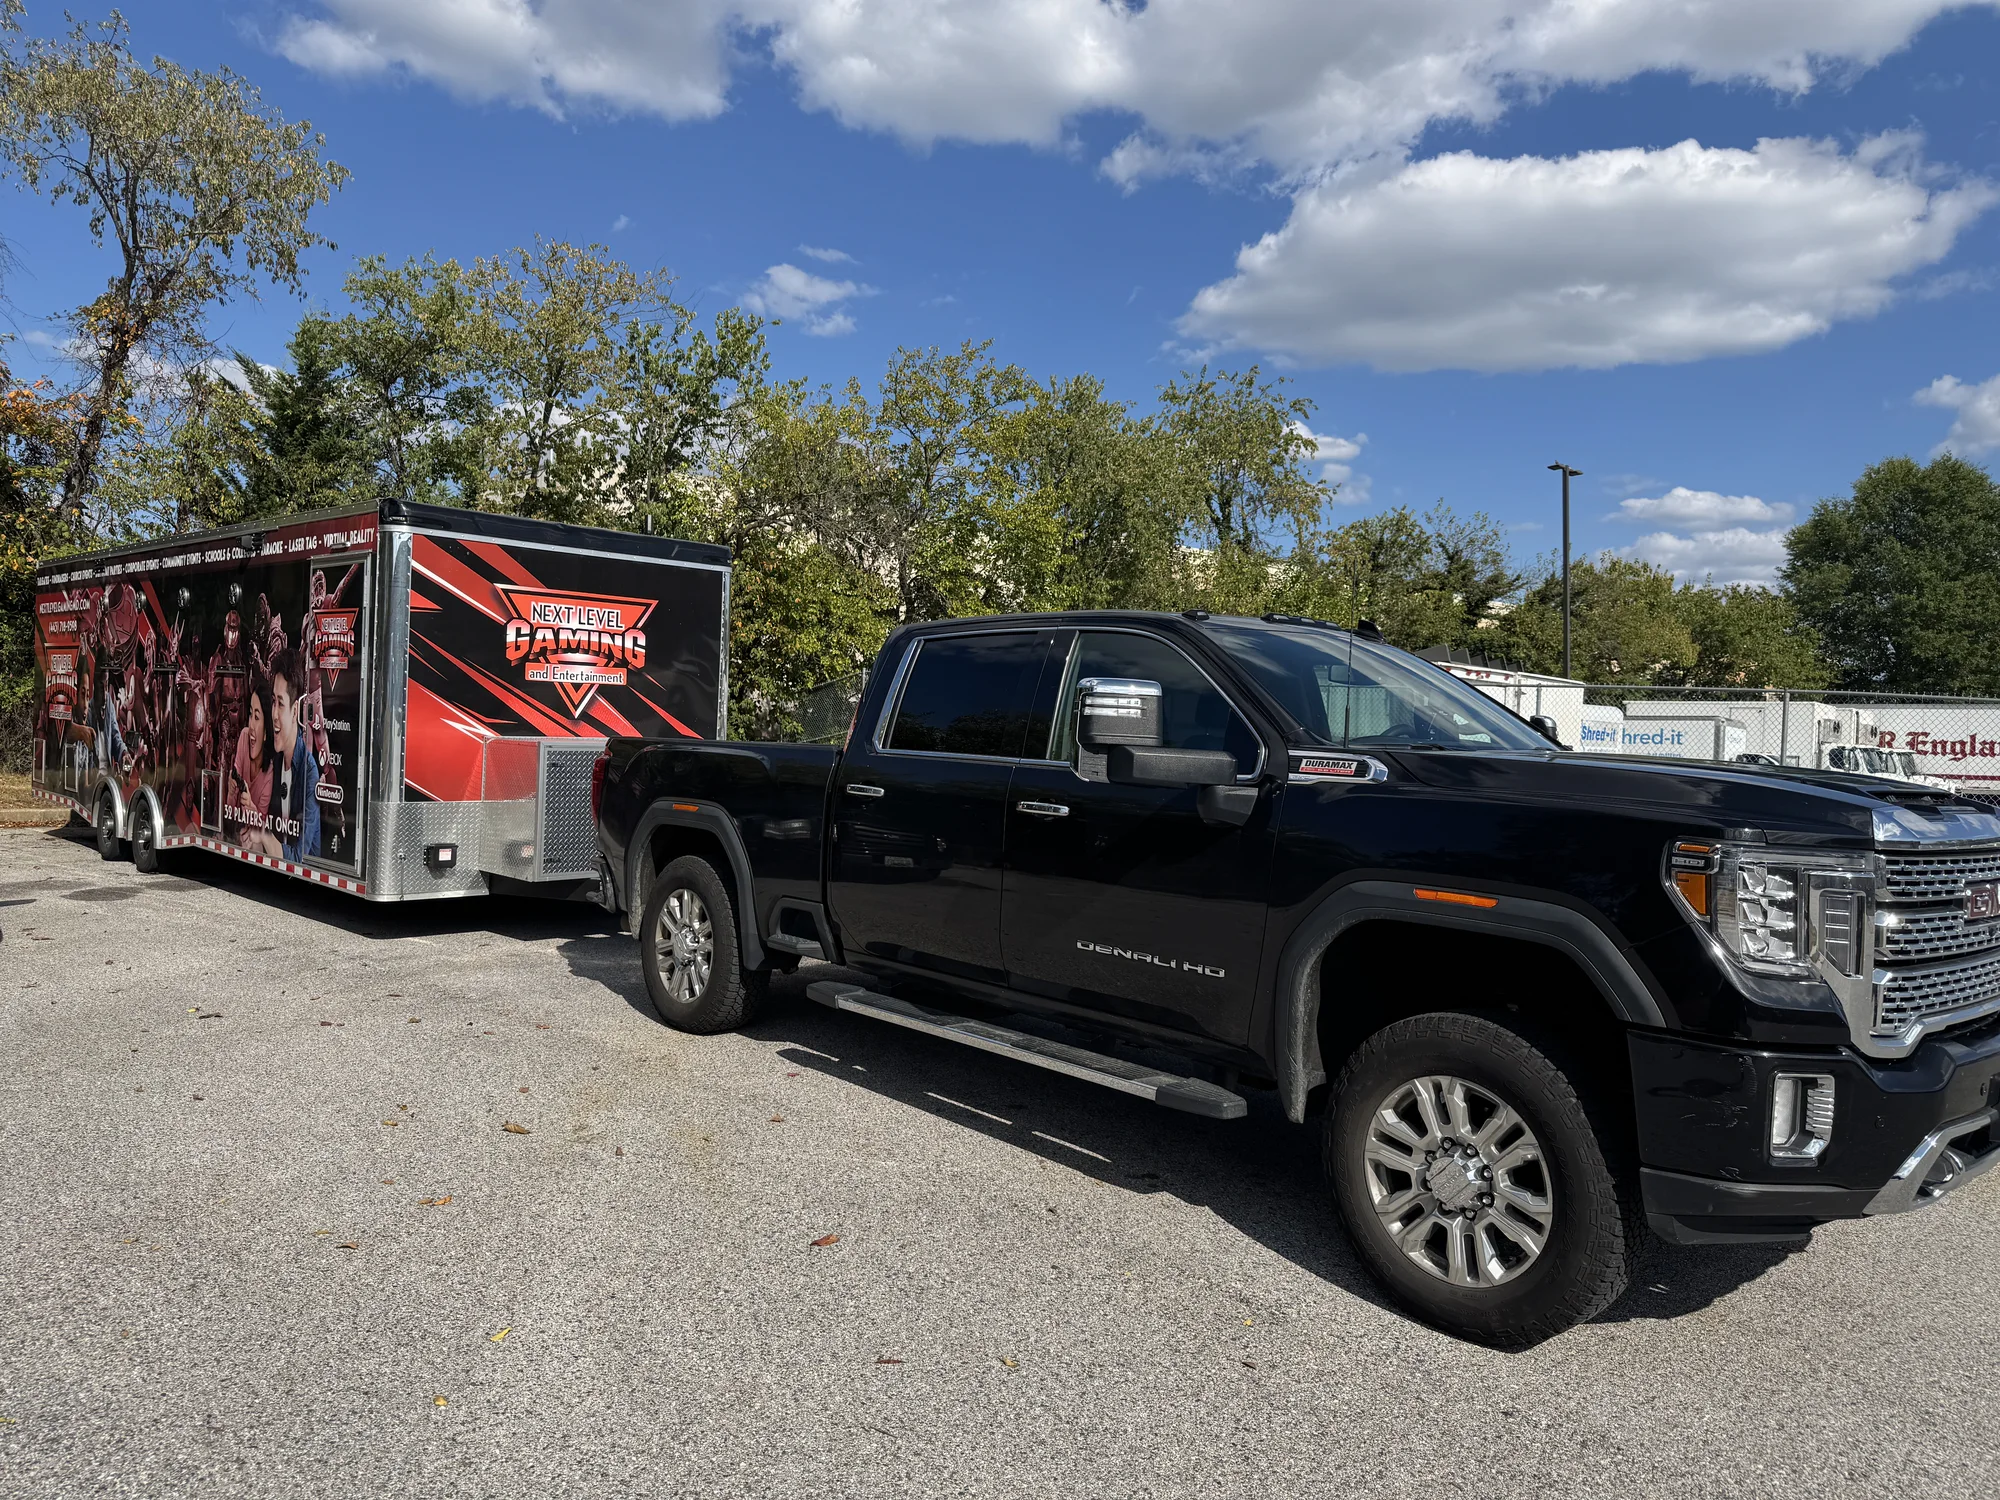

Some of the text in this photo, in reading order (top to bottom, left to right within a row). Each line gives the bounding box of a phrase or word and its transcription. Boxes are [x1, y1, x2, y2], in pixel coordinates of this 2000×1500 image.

[205, 549, 226, 562] SCHOOLS
[289, 538, 305, 553] LASER
[305, 536, 317, 550] TAG
[350, 527, 375, 544] REALITY
[532, 603, 624, 629] NEXT LEVEL
[315, 630, 354, 657] GAMING
[506, 619, 646, 669] GAMING
[529, 665, 623, 683] and Entertainment
[46, 670, 78, 705] GAMING
[323, 718, 351, 733] PlayStation
[1581, 725, 1616, 742] Shred-it
[1622, 727, 1684, 745] hred-it
[1905, 731, 2000, 762] Engla
[1304, 760, 1354, 769] DURAMAX
[317, 787, 341, 801] Nintendo
[234, 807, 262, 828] PLAYERS
[265, 815, 273, 831] AT
[276, 817, 300, 837] ONCE!
[1076, 940, 1225, 978] DENALI HD
